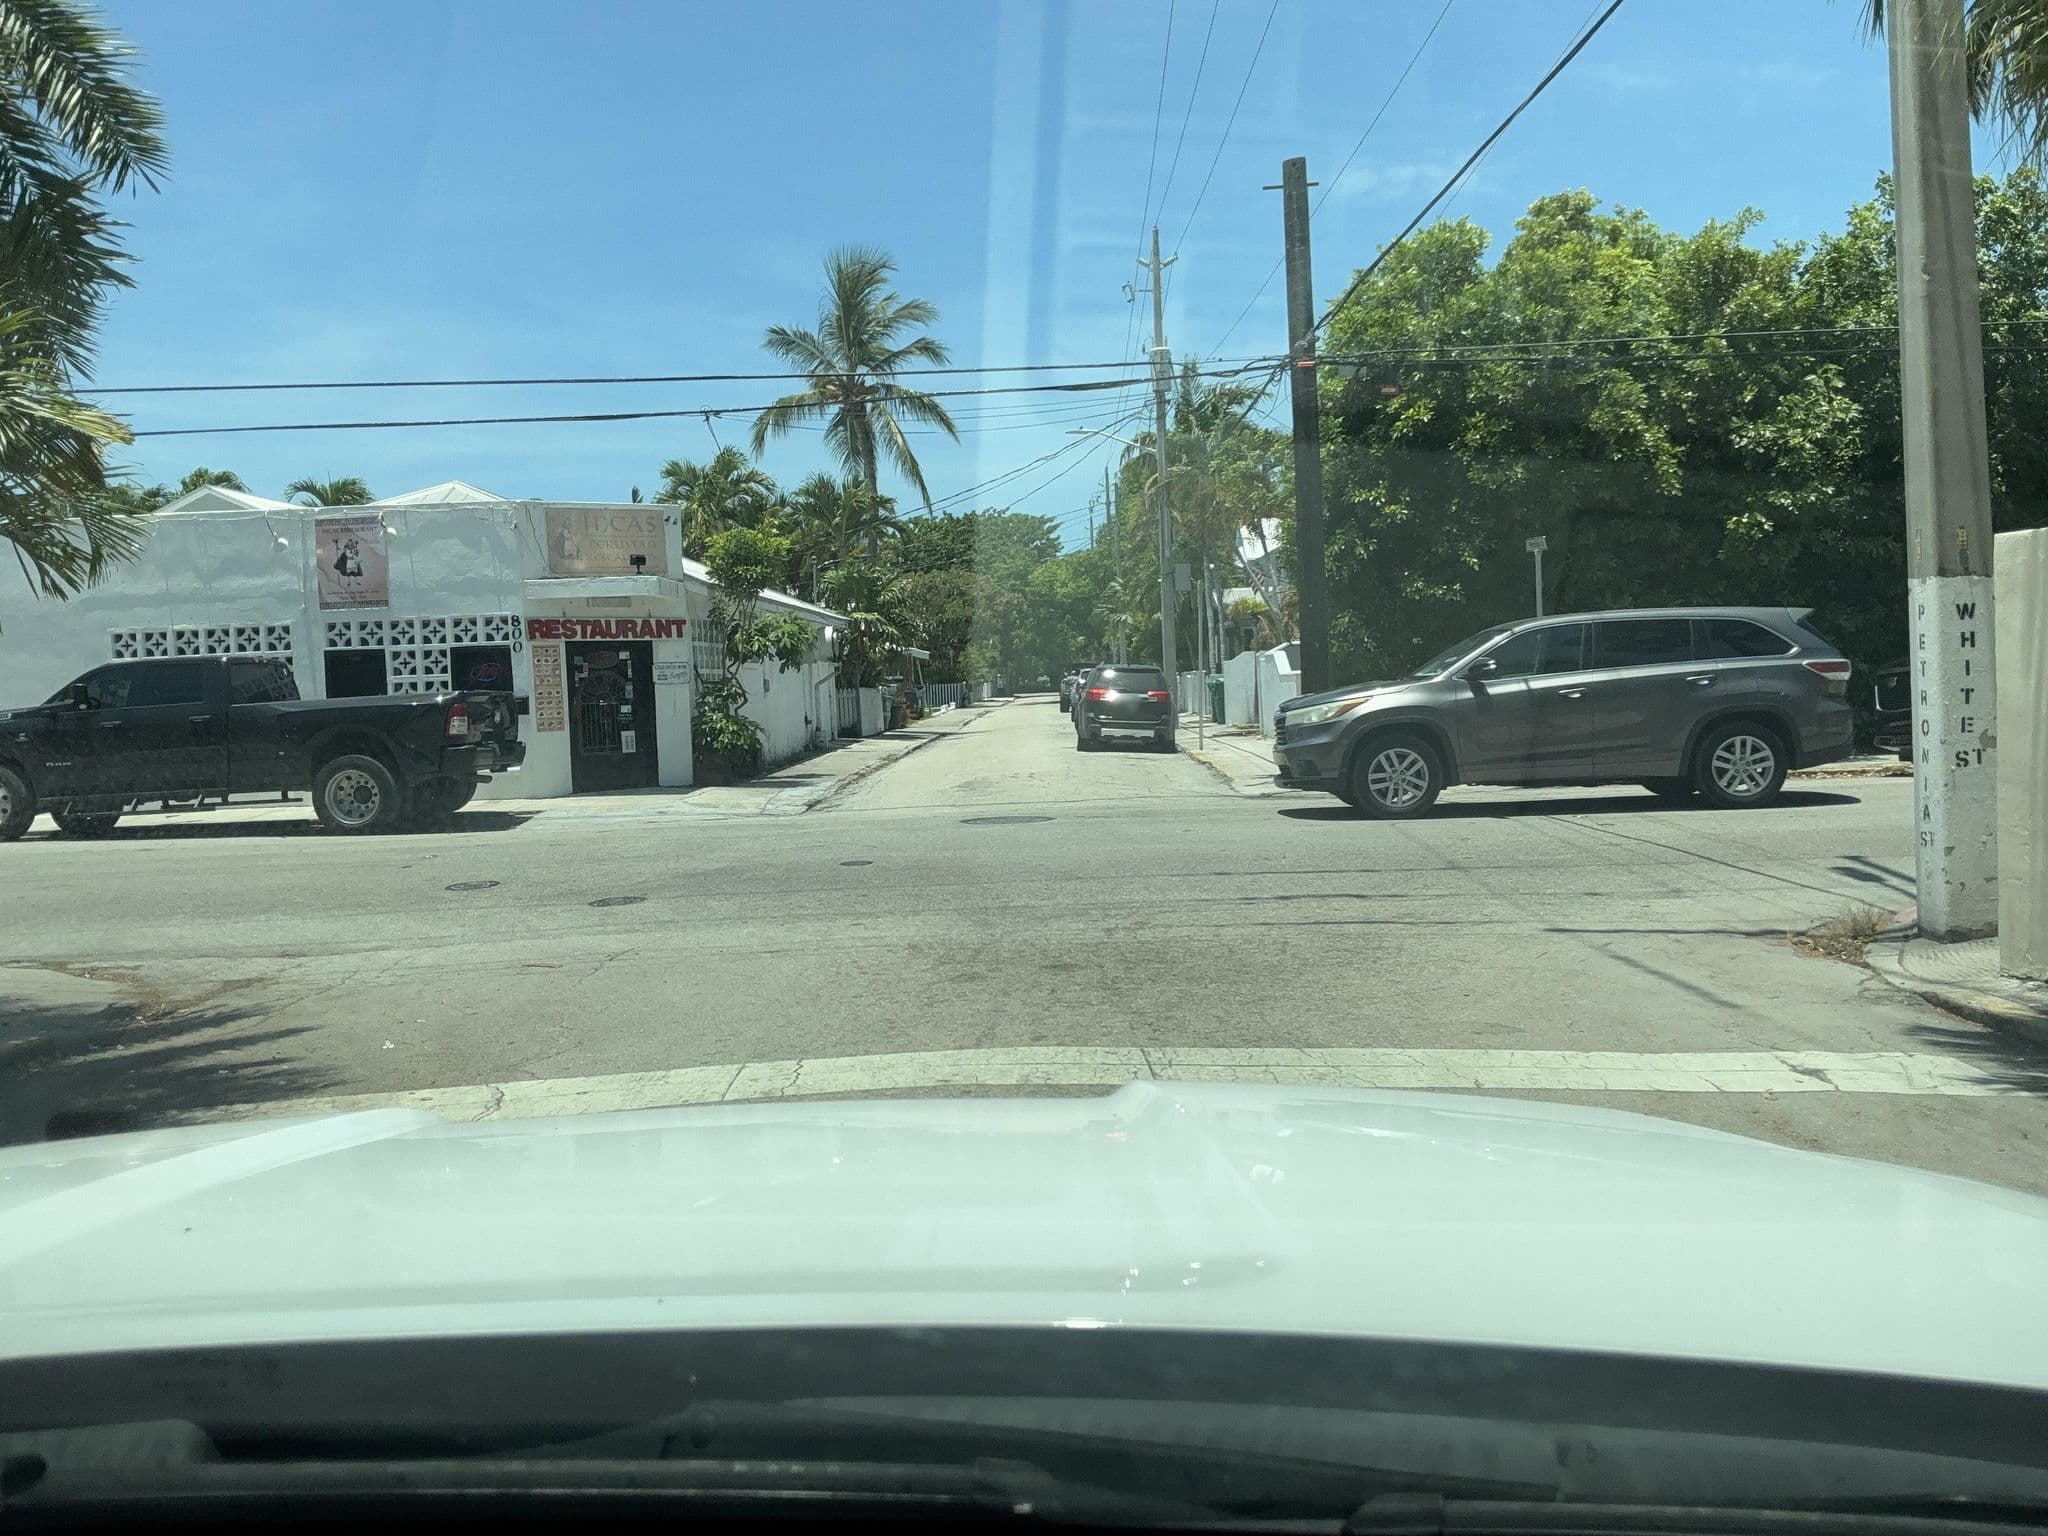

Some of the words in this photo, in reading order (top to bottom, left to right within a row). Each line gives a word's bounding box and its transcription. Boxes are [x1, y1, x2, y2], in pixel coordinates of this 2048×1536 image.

[511, 614, 523, 654] 800
[527, 619, 687, 640] RESTAURANT
[1955, 602, 1976, 733] WHITE
[1918, 604, 1931, 821] PETRONIA
[1954, 748, 1987, 768] ST
[1919, 831, 1936, 847] ST
